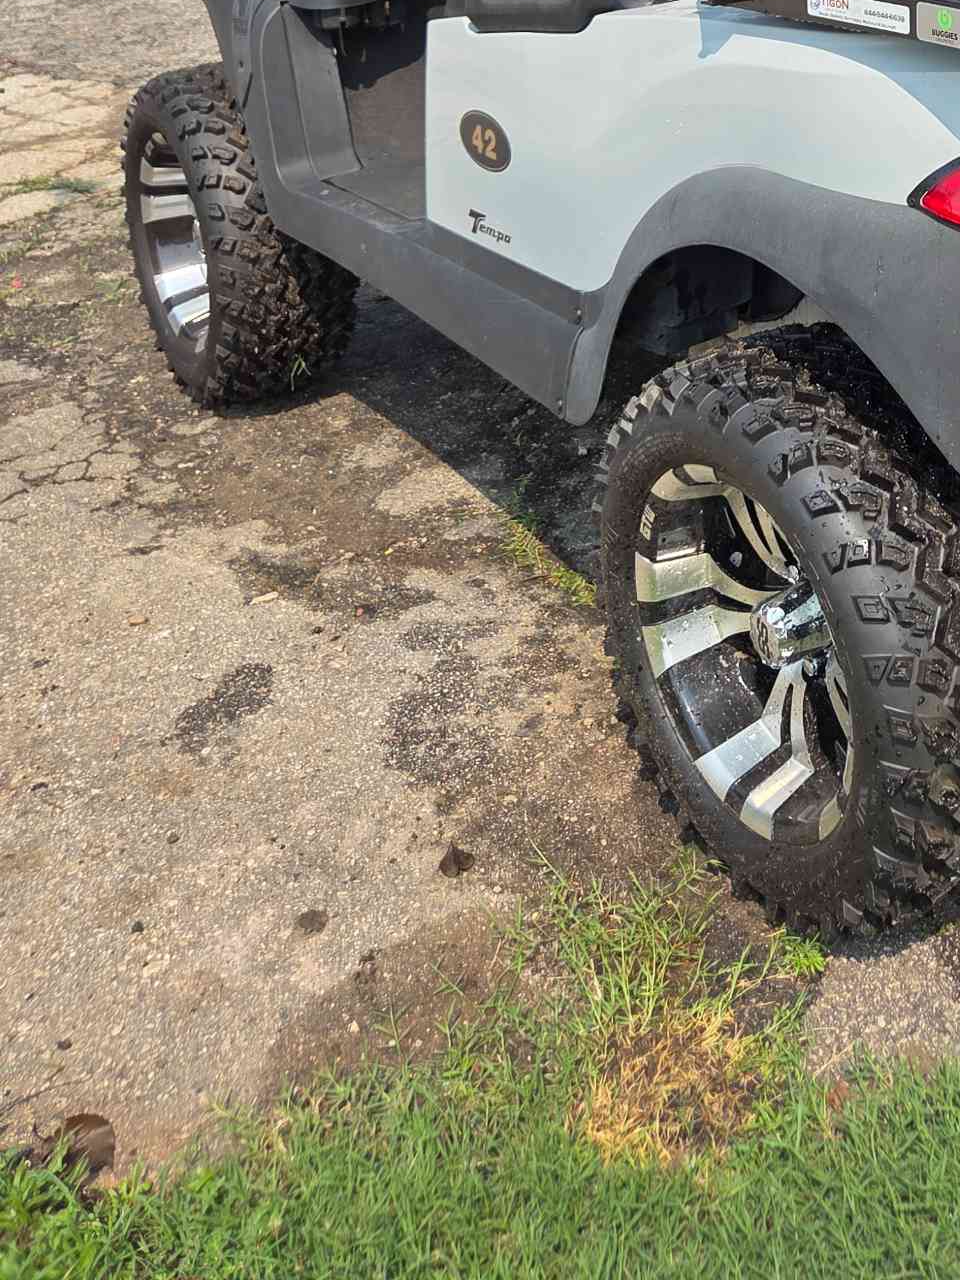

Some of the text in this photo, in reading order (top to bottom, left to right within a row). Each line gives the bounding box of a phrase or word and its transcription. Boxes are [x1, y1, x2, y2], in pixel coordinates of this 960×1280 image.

[931, 28, 958, 41] BUGGIES
[471, 124, 497, 160] 42
[468, 208, 513, 244] Tempo
